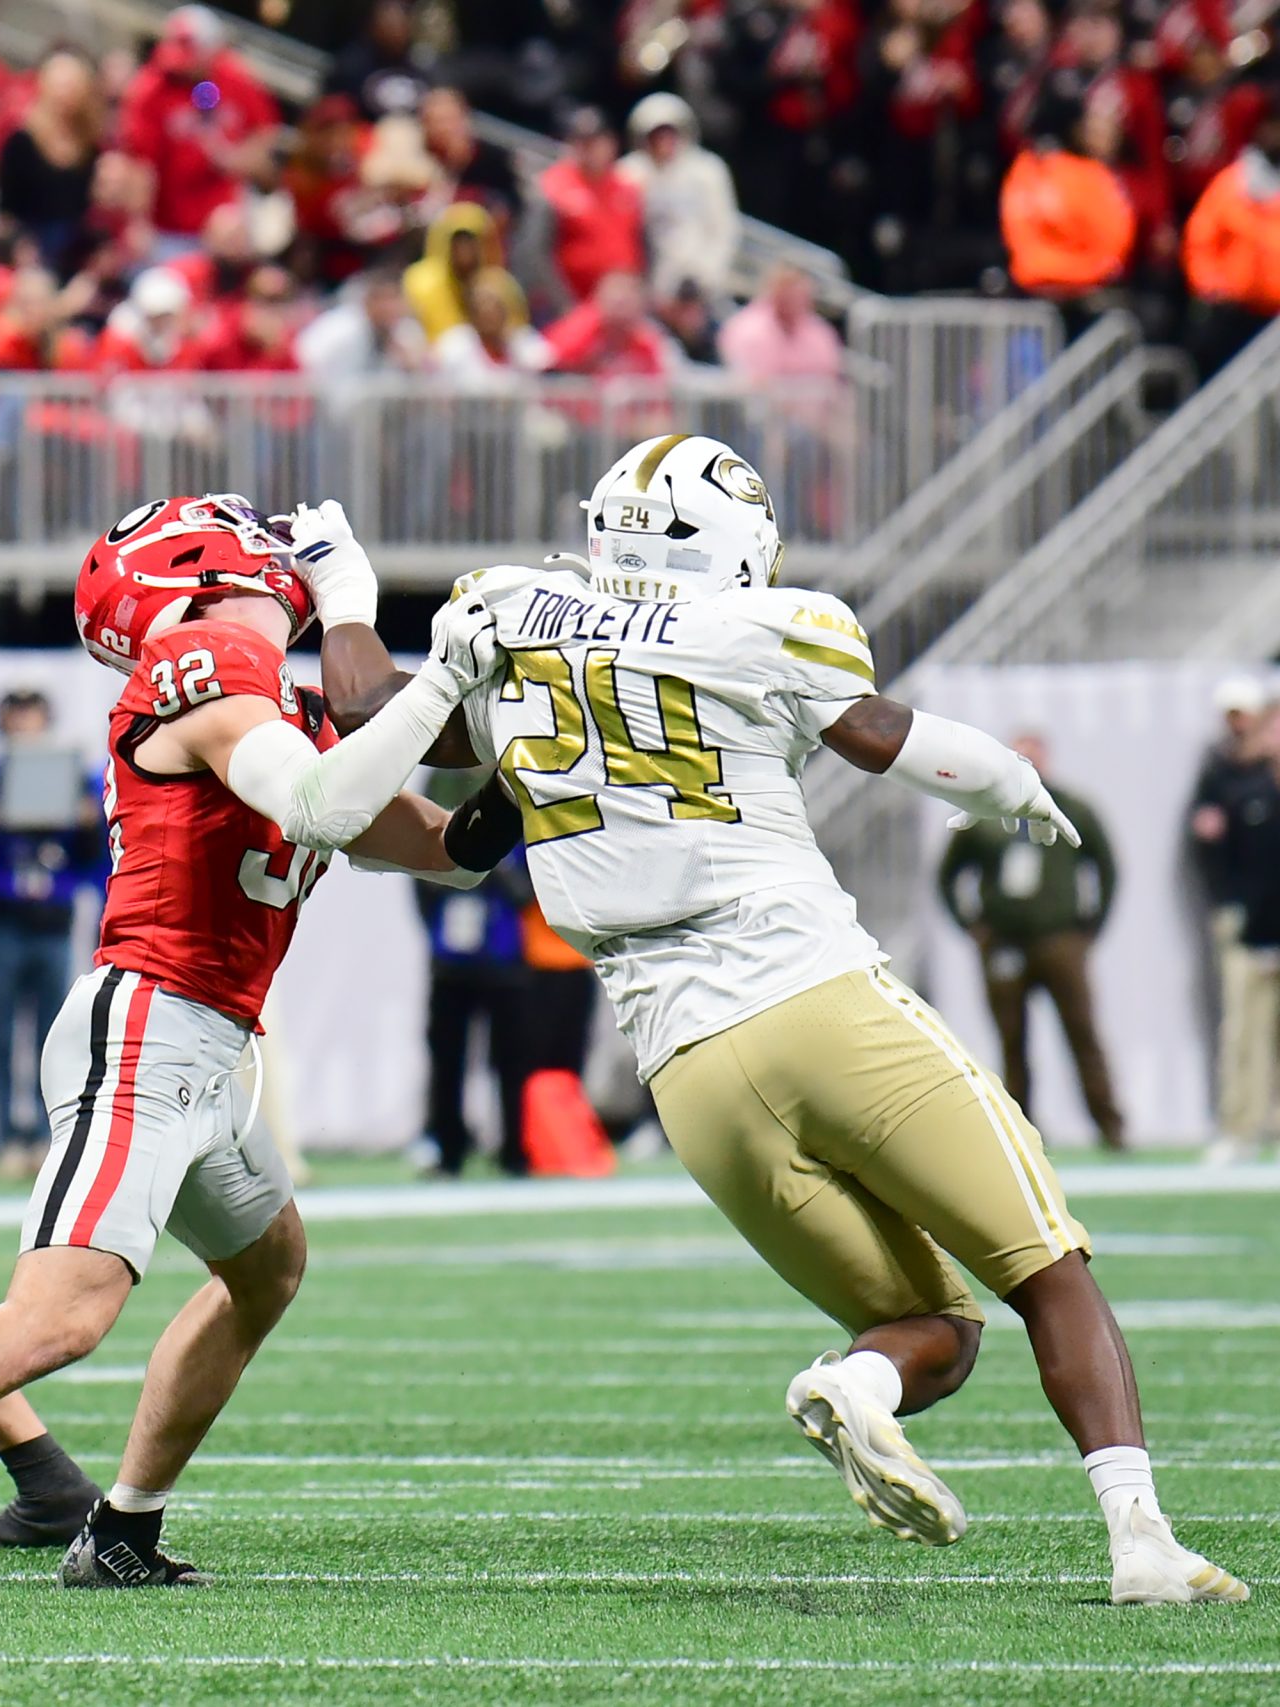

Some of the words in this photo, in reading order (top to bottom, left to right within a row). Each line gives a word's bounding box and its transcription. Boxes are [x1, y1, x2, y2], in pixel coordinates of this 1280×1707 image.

[620, 505, 650, 529] 24
[620, 557, 642, 567] ACC
[596, 577, 678, 600] JACKETS
[517, 588, 690, 645] TRIPLETTE
[150, 648, 223, 717] 32
[498, 647, 742, 847] 24
[178, 1087, 191, 1106] G
